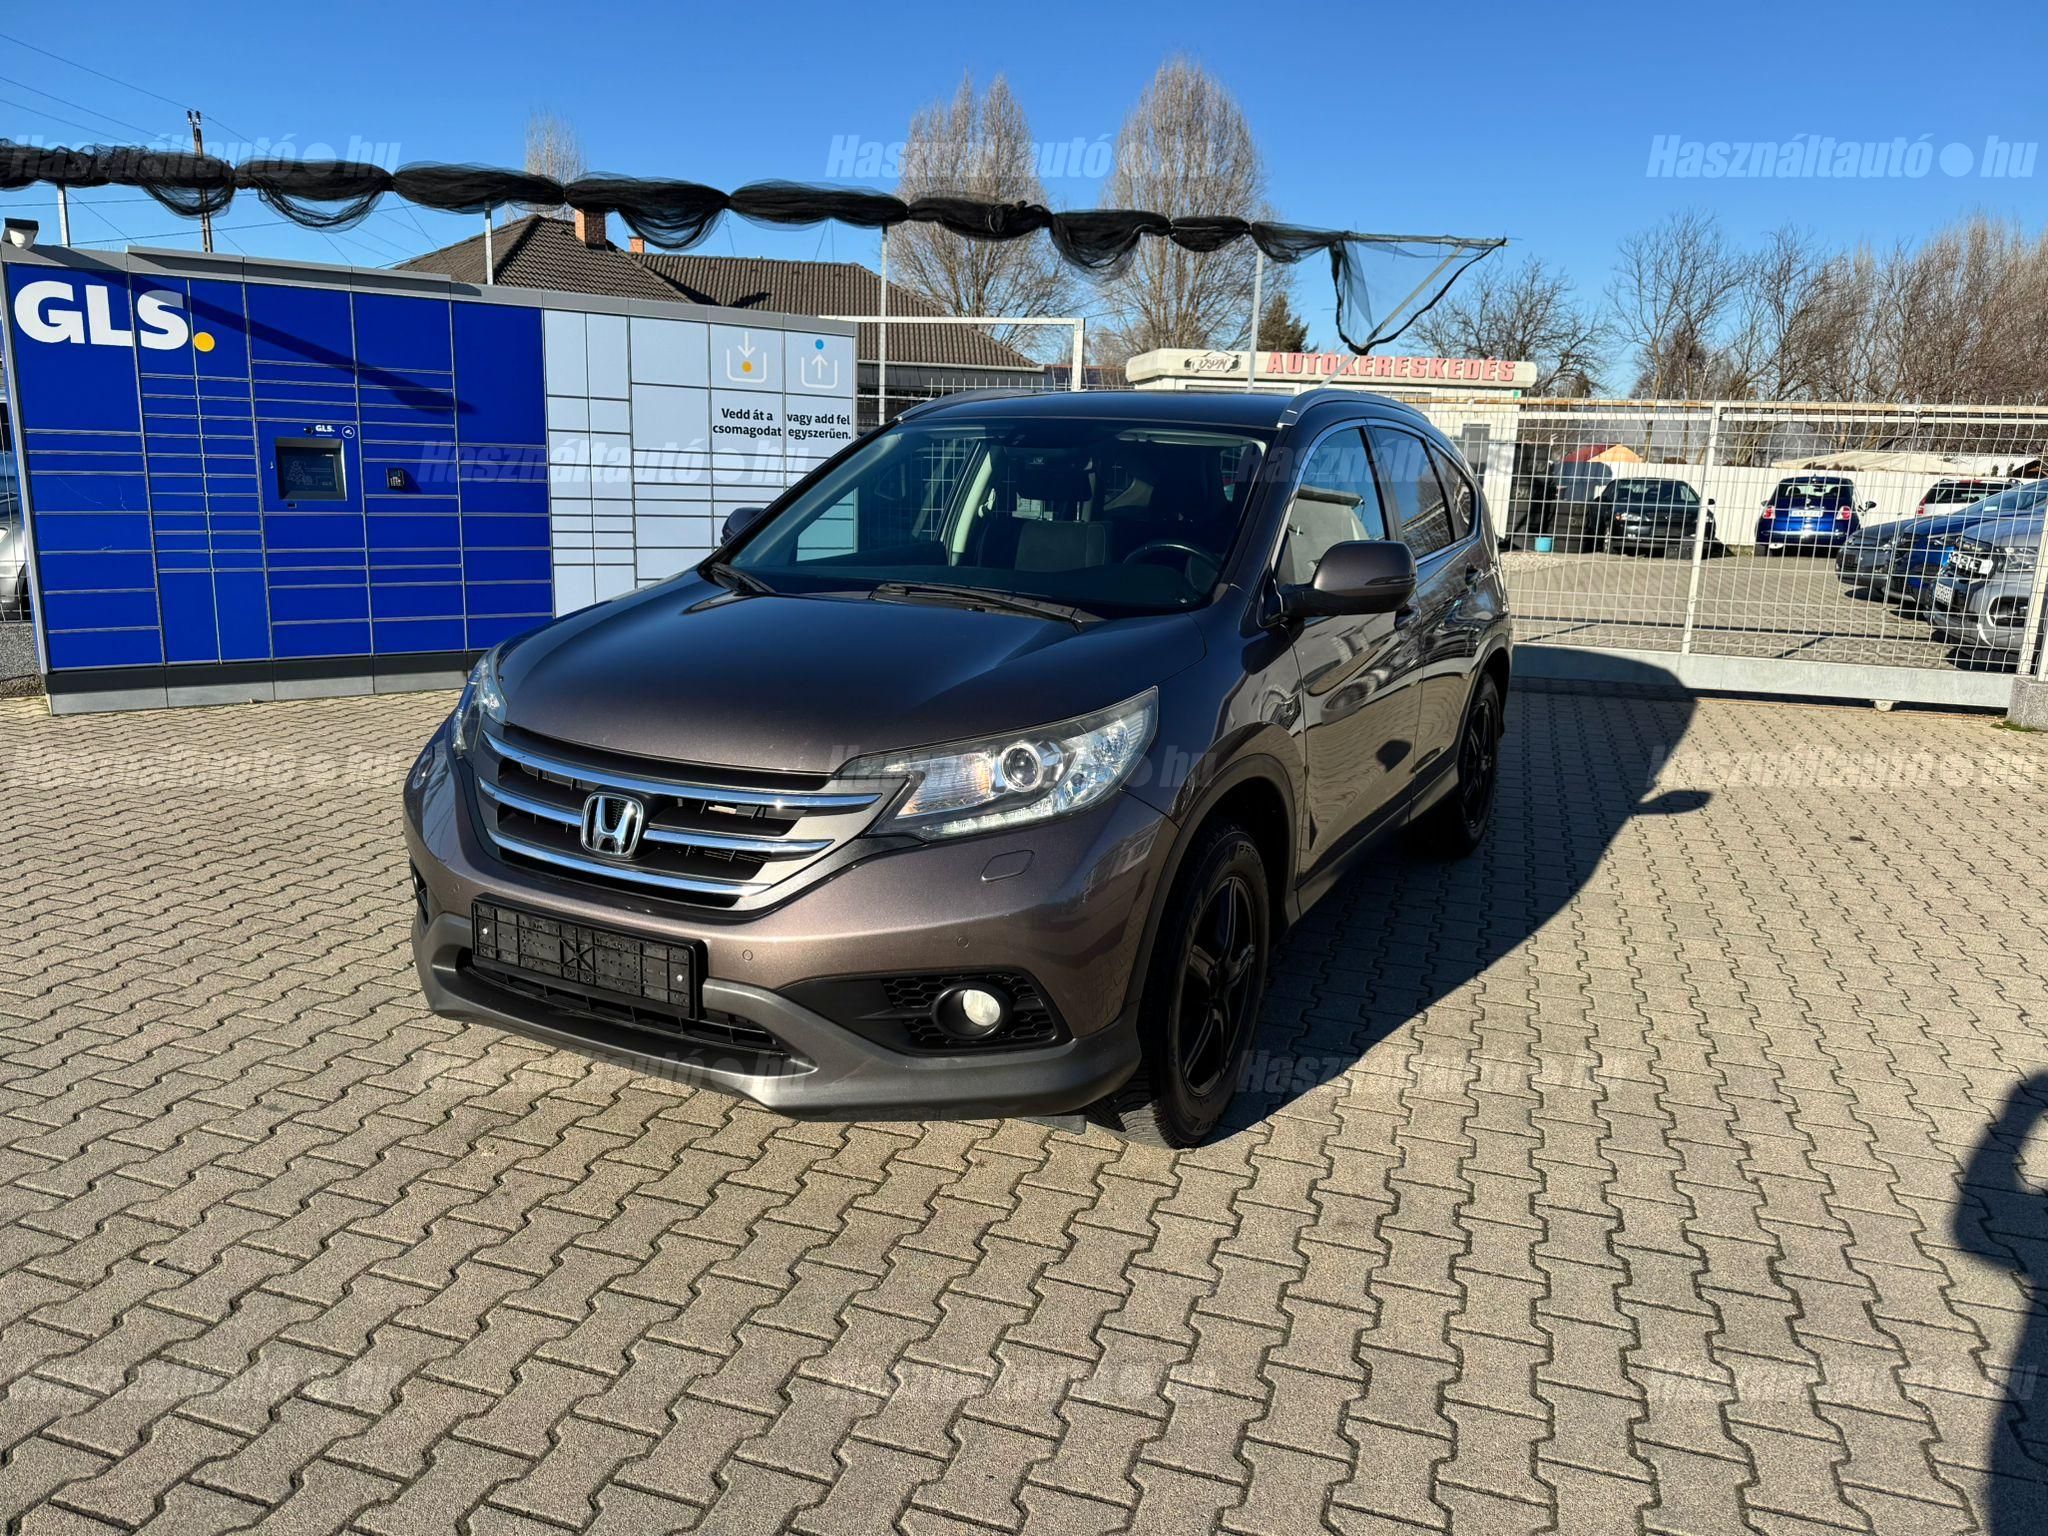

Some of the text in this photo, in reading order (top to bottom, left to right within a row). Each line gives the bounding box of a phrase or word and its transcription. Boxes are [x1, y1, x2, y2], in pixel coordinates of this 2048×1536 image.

[1266, 352, 1515, 381] AUTÓKERESKEDÉS
[721, 408, 773, 421] Vedd át a
[787, 413, 850, 426] vagy add fel
[712, 425, 782, 438] csomagodat
[788, 428, 851, 440] egyszerűen.
